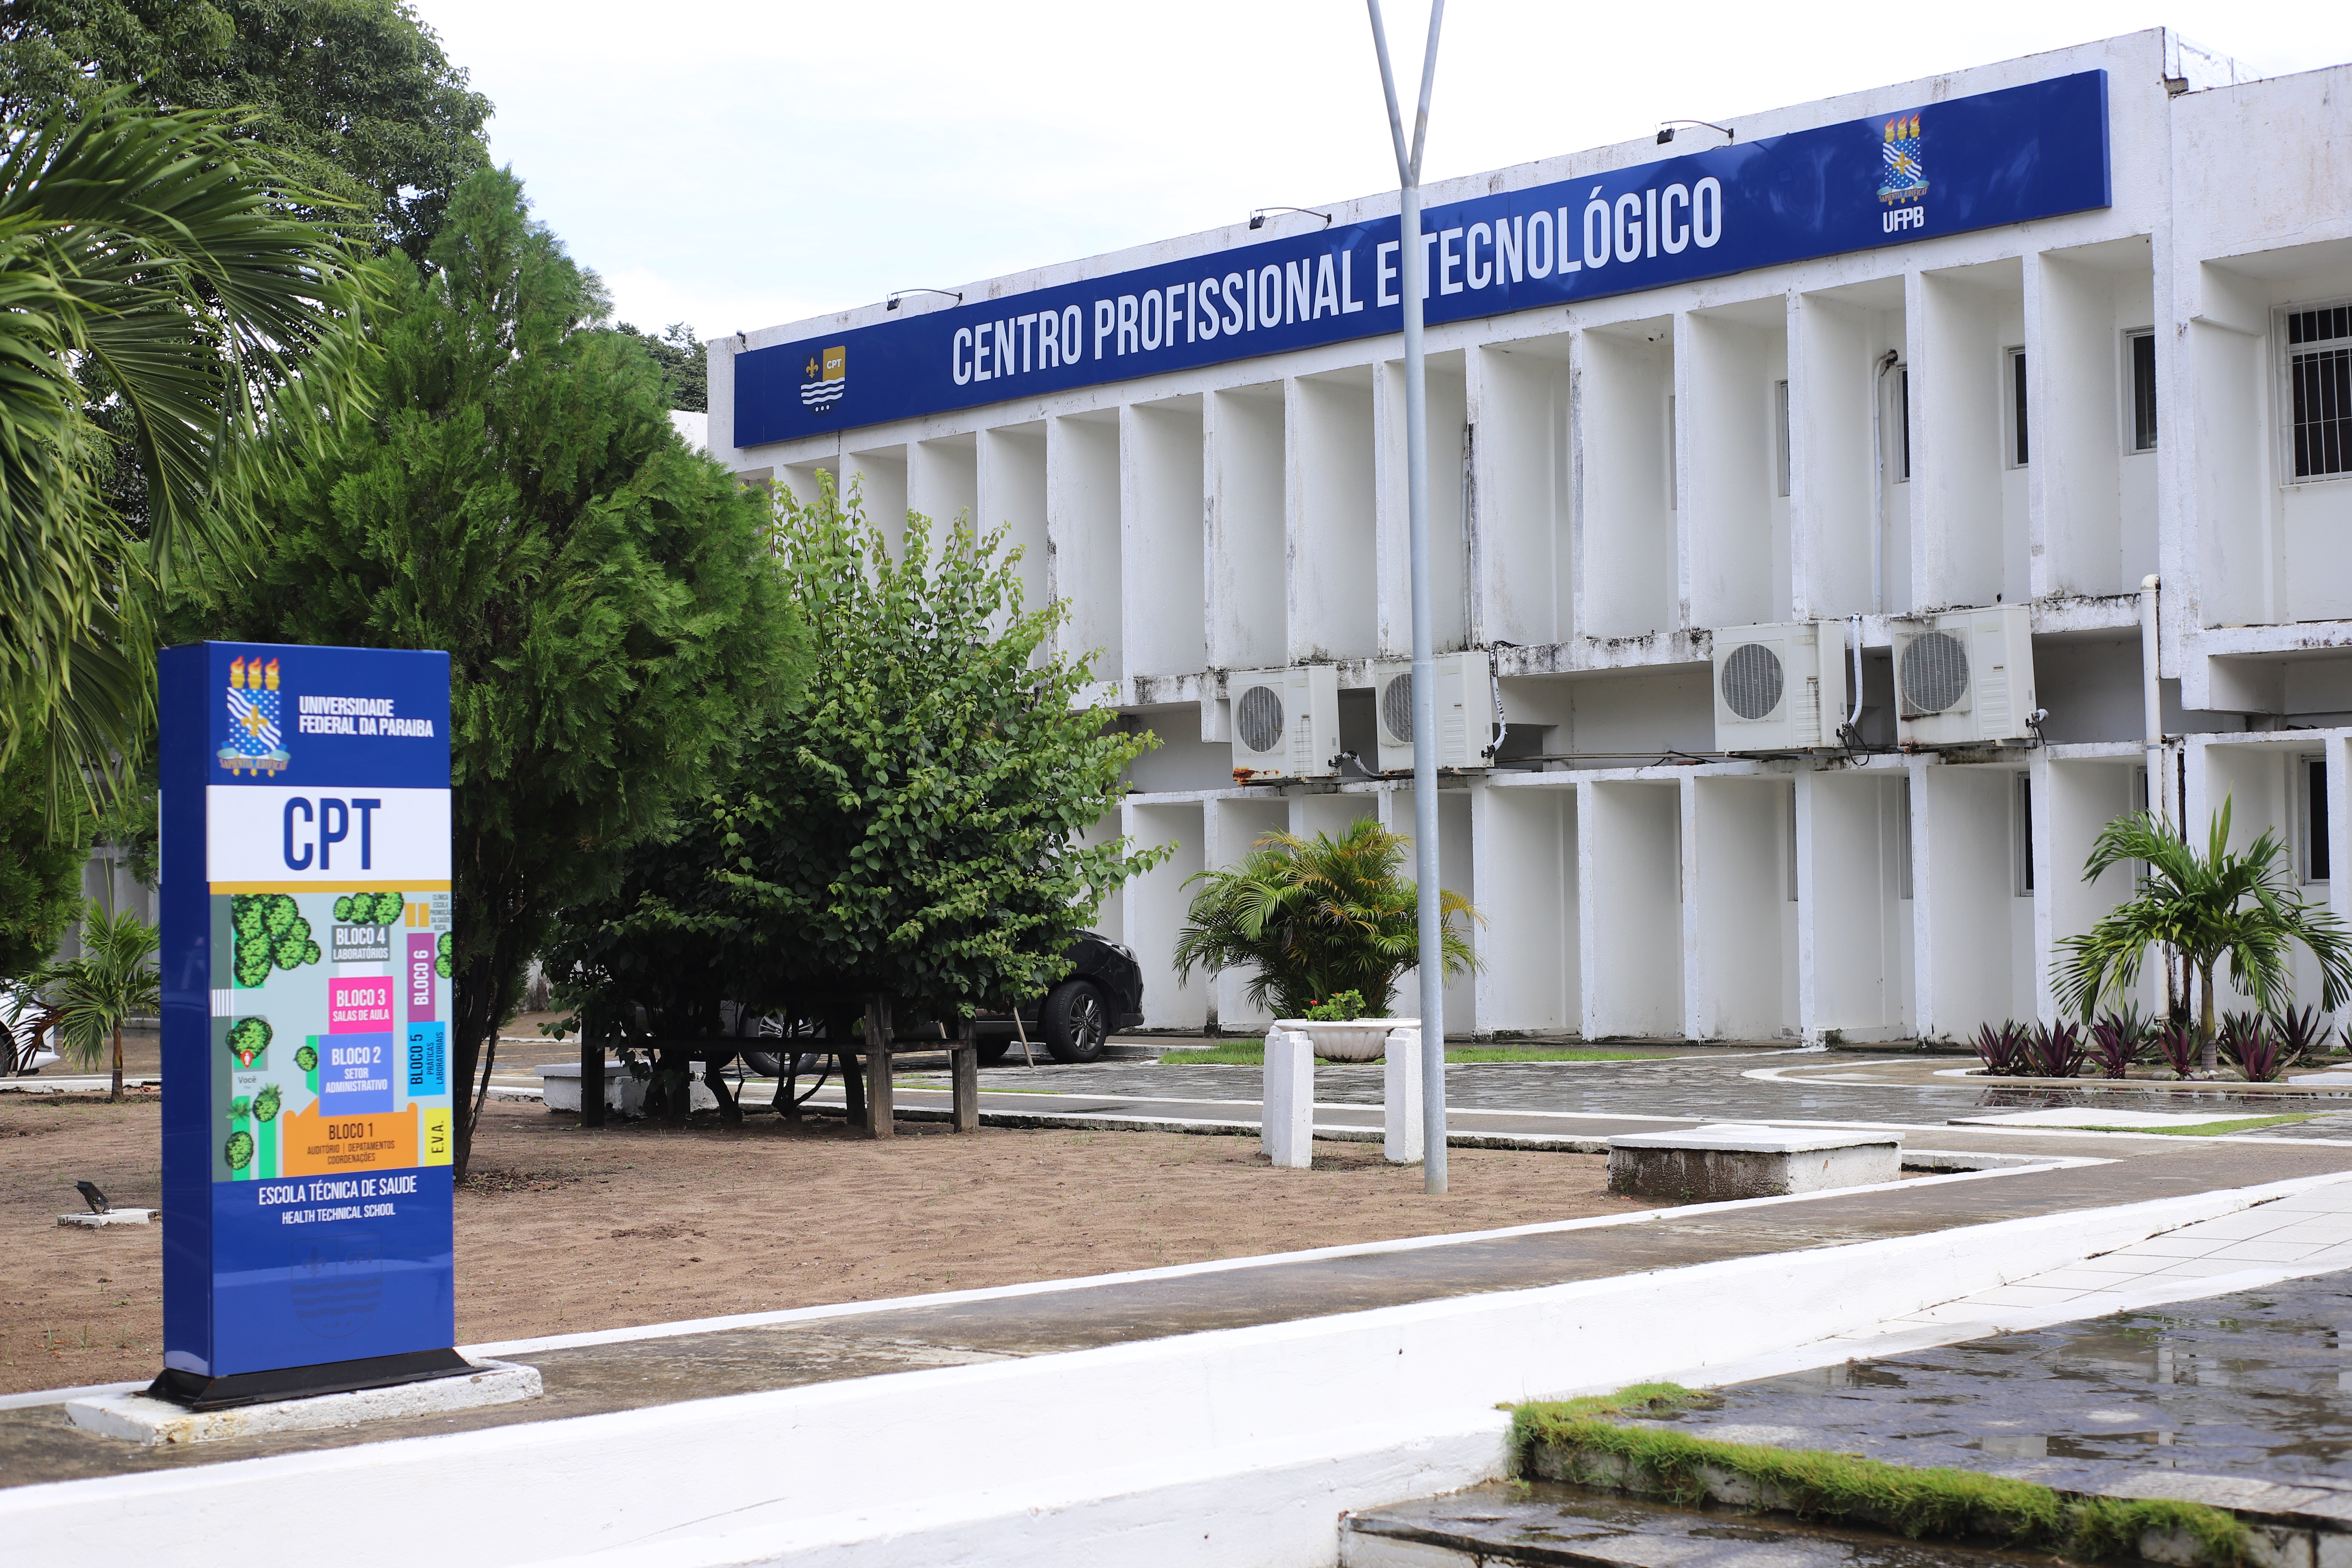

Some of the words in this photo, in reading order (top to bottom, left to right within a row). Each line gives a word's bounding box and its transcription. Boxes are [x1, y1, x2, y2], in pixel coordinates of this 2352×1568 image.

[1879, 191, 1903, 202] SAPIENTIA
[1883, 205, 1925, 233] UFPB
[952, 304, 1082, 386] CENTRO
[1095, 249, 1364, 360] PROFISSIONAL
[1377, 240, 1399, 308] E
[1420, 176, 1722, 300] TECNOLÓGICO
[826, 358, 842, 370] CPT
[299, 695, 394, 717] UNIVERSIDADE
[299, 715, 358, 735] FEDERAL
[359, 717, 377, 736] DA
[379, 718, 434, 737] PARAÍBA
[283, 796, 381, 871] CPT
[336, 927, 375, 945] BLOCO
[376, 927, 386, 944] 4
[333, 946, 389, 960] LABORATÓRIOS
[413, 949, 429, 959] 6
[413, 962, 429, 1005] BLOCO
[336, 989, 375, 1007] BLOCO
[377, 988, 386, 1006] 3
[332, 1010, 358, 1022] SALAS
[358, 1009, 369, 1021] DE
[369, 1008, 390, 1020] AULA
[331, 1046, 371, 1066] BLOCO
[372, 1046, 381, 1063] 2
[410, 1046, 423, 1085] BLOCO
[425, 1042, 434, 1075] PRÁTICAS
[237, 1075, 257, 1084] Você
[344, 1067, 369, 1080] SETOR
[325, 1078, 388, 1093] ADMINISTRATIVO
[329, 1123, 364, 1140] BLOCO
[368, 1122, 373, 1137] 1
[431, 1120, 444, 1154] E.V.A.
[307, 1143, 339, 1155] AUDITÓRIO
[348, 1141, 395, 1152] DEPATAMENTOS
[328, 1152, 375, 1165] COORDENAÇÕES
[259, 1185, 306, 1205] ESCOLA
[308, 1179, 359, 1201] TÉCNICA
[361, 1179, 377, 1197] DE
[379, 1175, 418, 1196] SAUDE
[282, 1210, 315, 1225] HEALTH
[316, 1206, 362, 1222] TECHNICAL
[363, 1203, 396, 1217] SCHOOL
